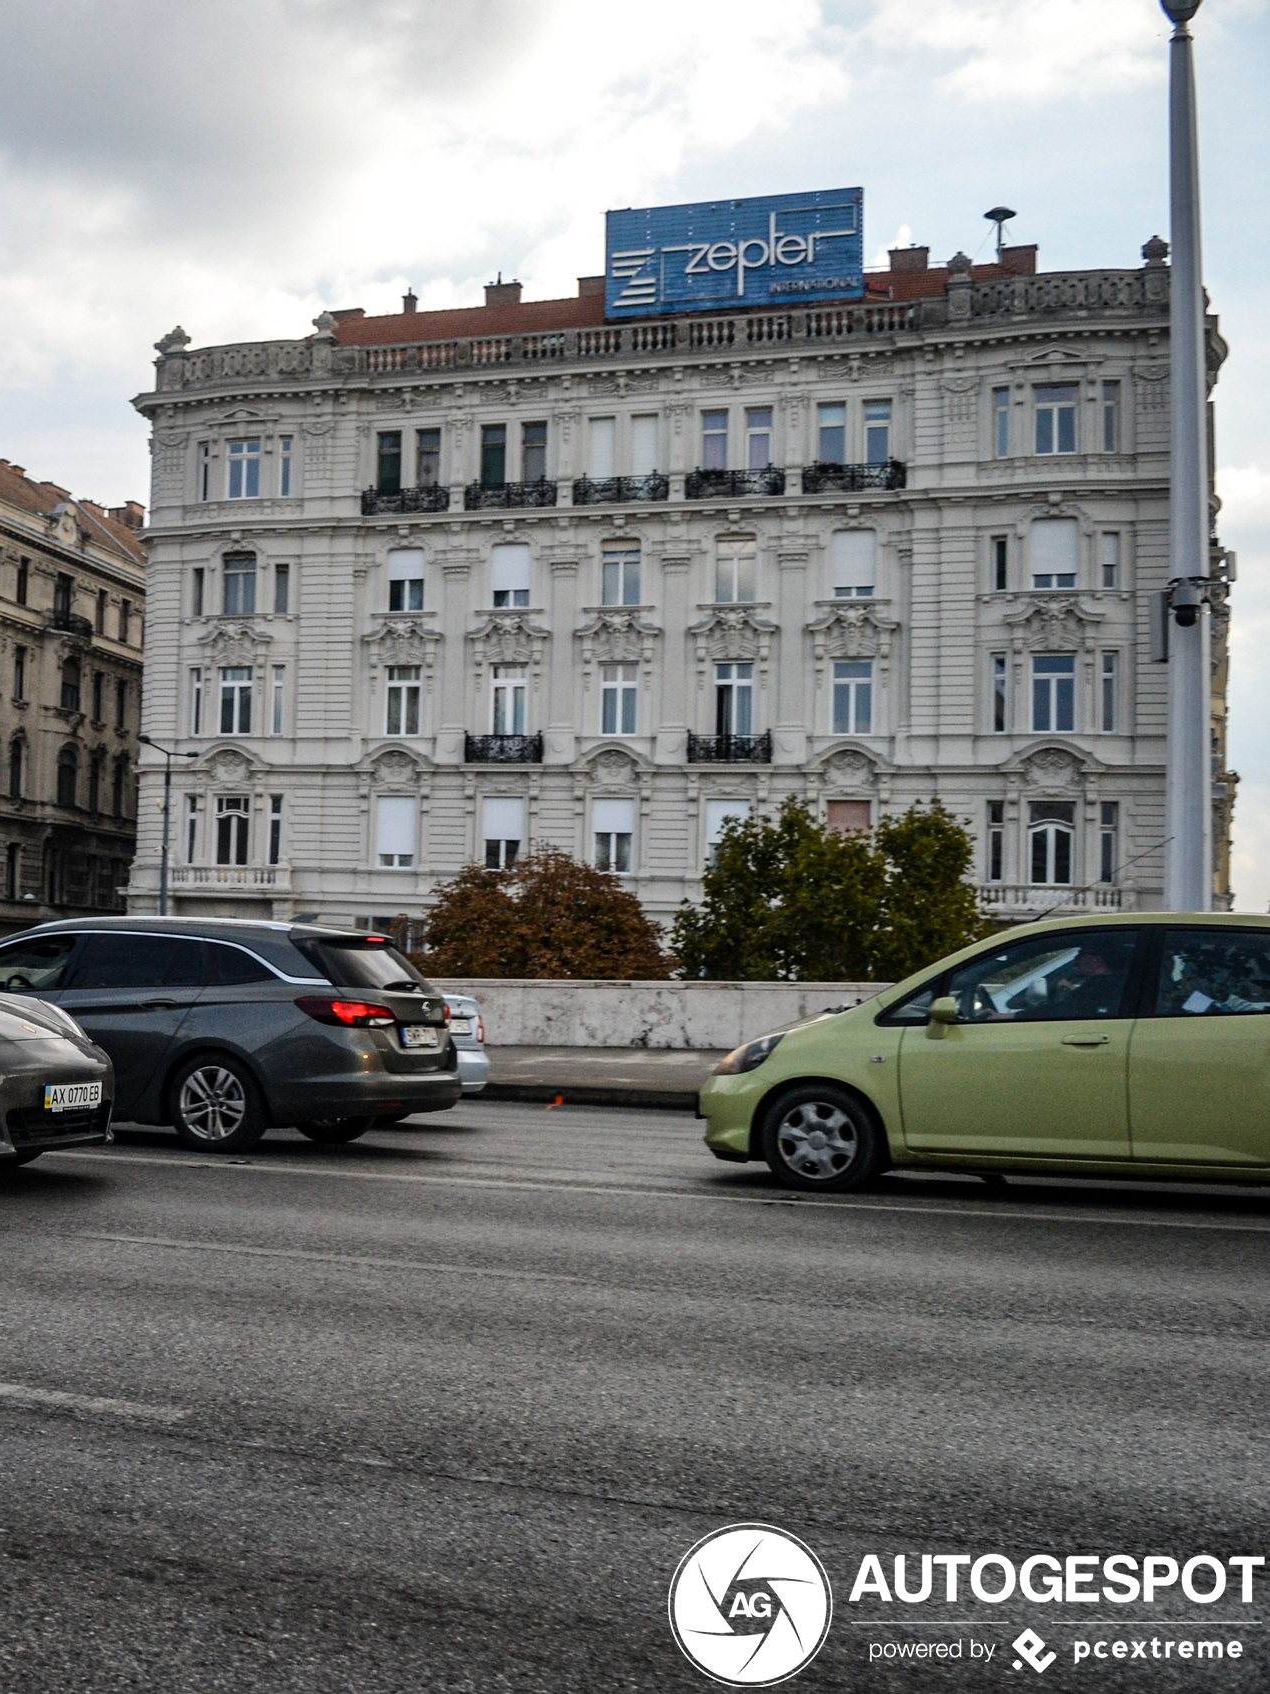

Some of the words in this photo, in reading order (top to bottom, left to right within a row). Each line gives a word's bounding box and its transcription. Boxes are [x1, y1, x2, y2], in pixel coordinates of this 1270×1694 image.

[661, 211, 856, 296] zepter
[768, 276, 859, 294] INTERNATIONAL
[51, 1088, 66, 1105] AX
[68, 1086, 88, 1103] 0770
[89, 1085, 100, 1102] EB
